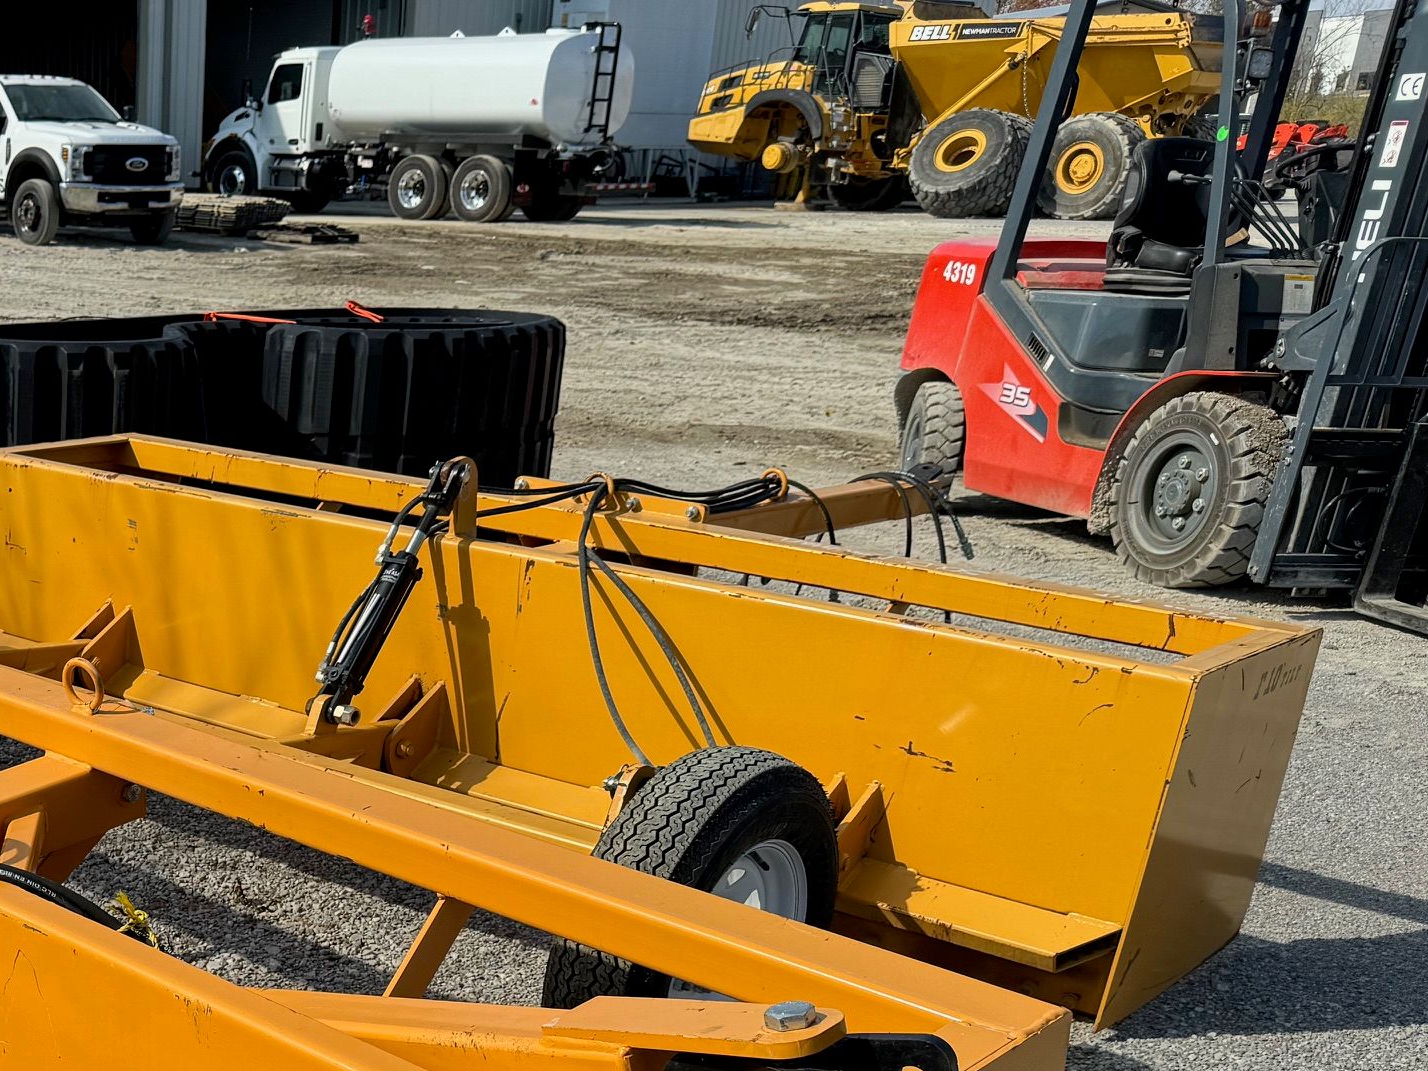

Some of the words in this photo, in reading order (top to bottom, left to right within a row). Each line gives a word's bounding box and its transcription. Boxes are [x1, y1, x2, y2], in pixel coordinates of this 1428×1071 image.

[910, 25, 951, 40] BELL
[943, 260, 976, 286] 4319
[999, 382, 1032, 408] 35
